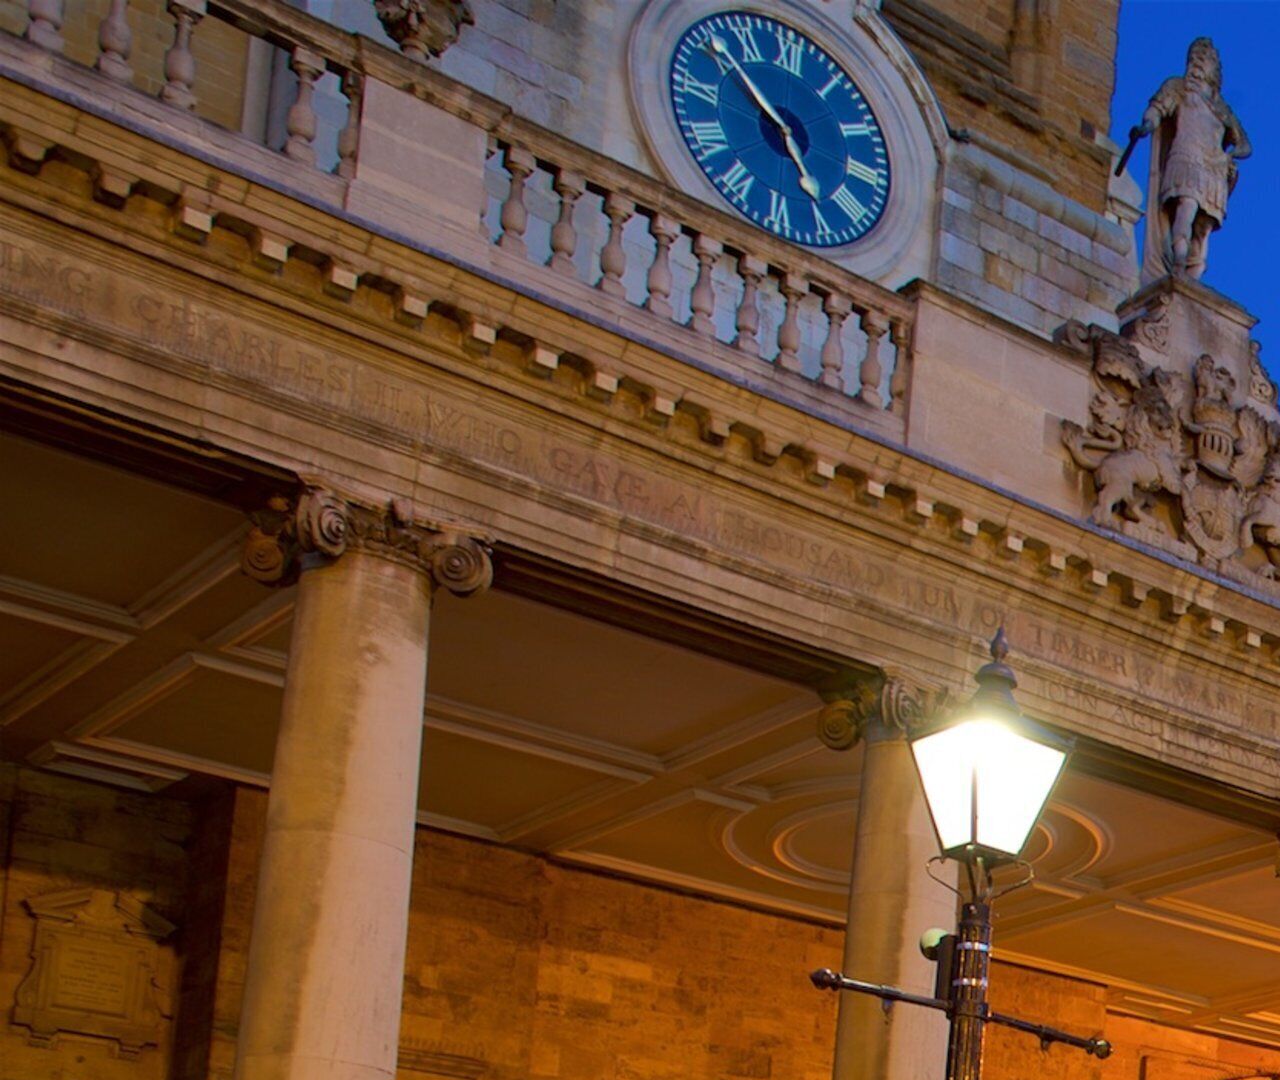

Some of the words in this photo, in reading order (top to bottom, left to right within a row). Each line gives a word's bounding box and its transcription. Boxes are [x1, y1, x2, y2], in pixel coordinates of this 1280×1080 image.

[731, 26, 764, 63] XI
[774, 33, 804, 77] XII
[680, 75, 719, 107] IX
[689, 121, 730, 157] VIII
[839, 122, 871, 138] II
[718, 159, 755, 201] VII
[846, 156, 879, 187] III
[769, 189, 790, 231] VI
[132, 289, 348, 395] CHARLES
[425, 398, 522, 458] WHO
[1028, 621, 1127, 676] TIMBER
